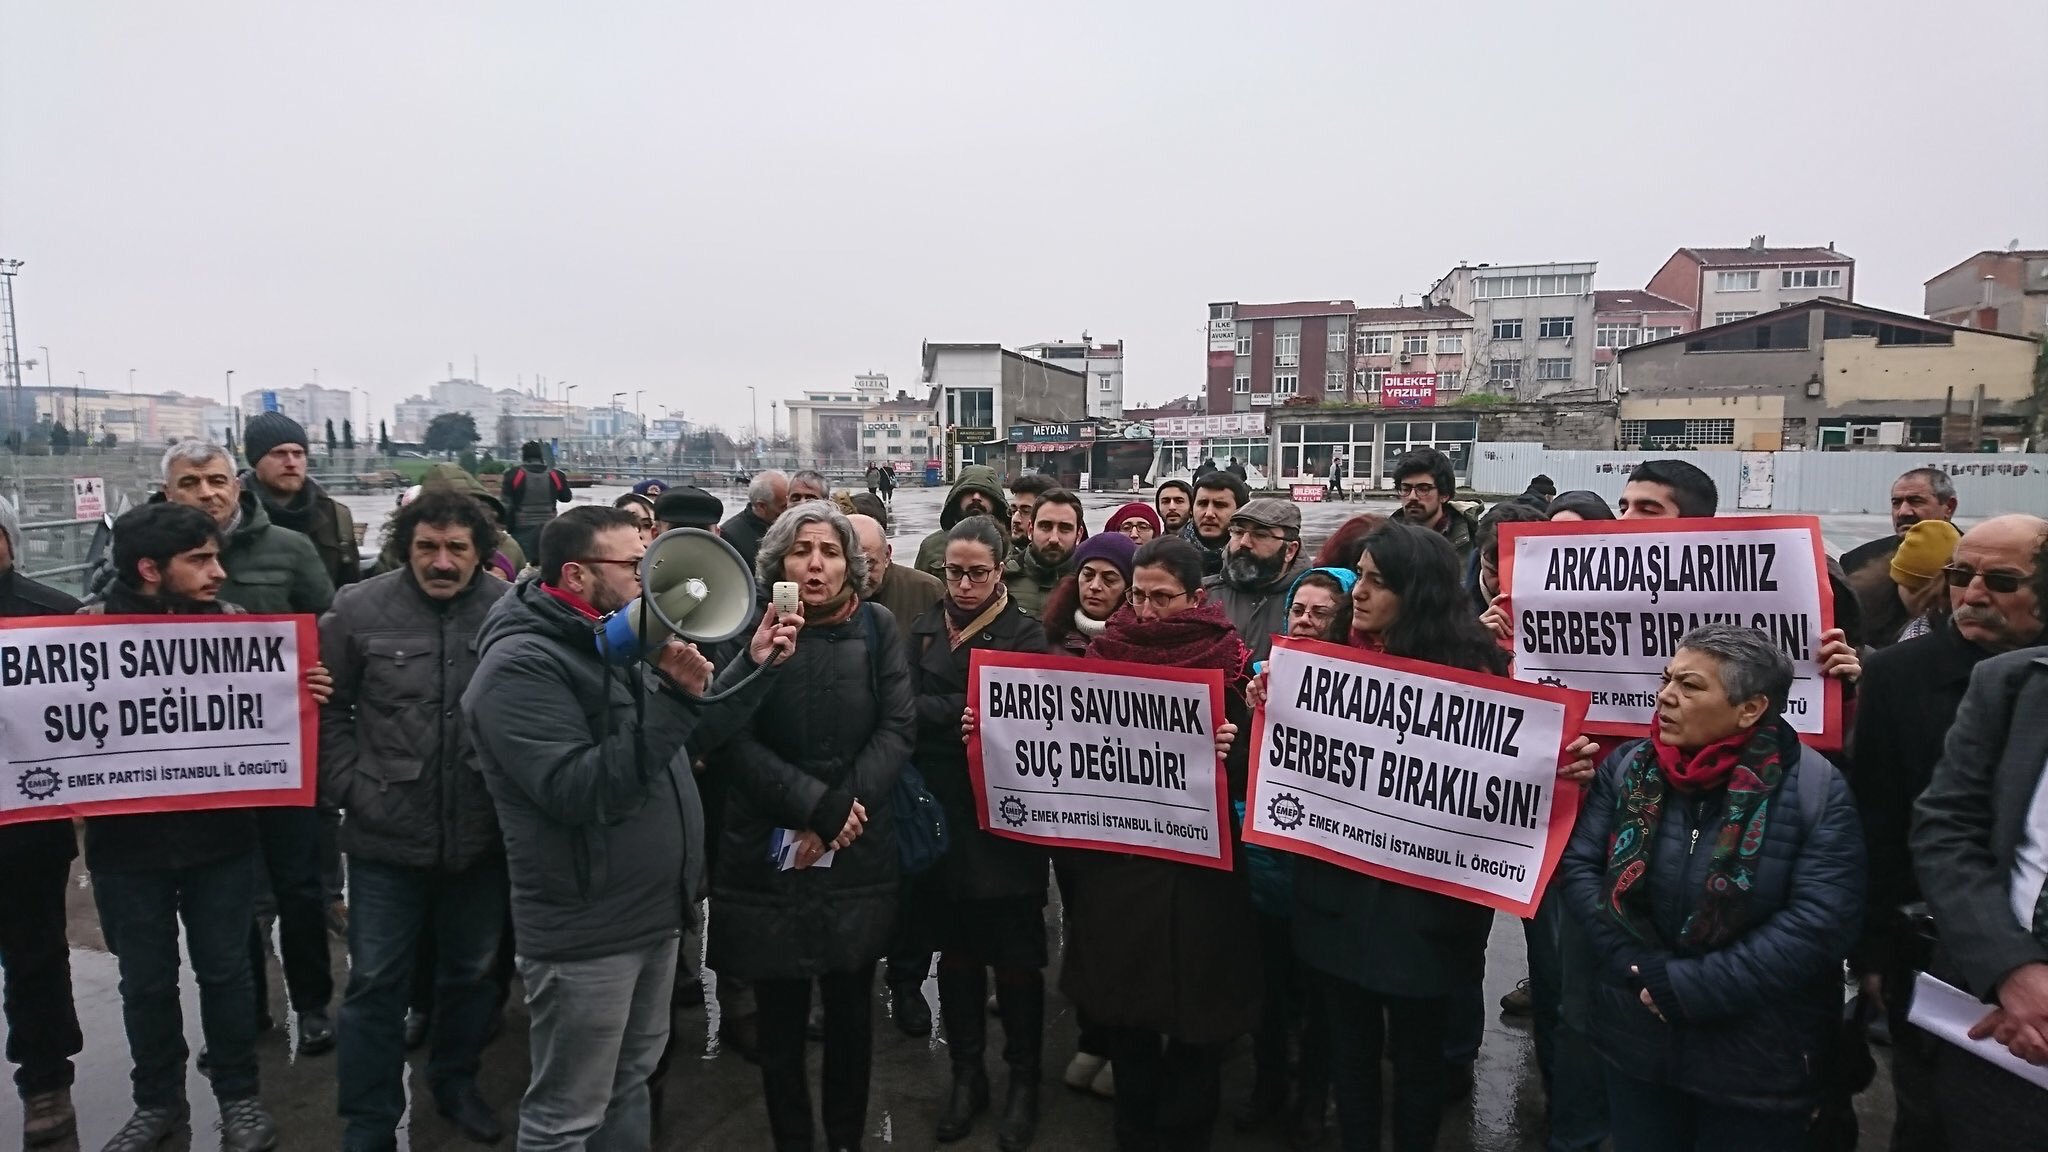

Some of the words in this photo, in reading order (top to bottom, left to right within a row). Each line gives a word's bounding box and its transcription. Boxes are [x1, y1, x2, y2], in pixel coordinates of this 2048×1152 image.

[1385, 376, 1434, 388] DİLEKÇE
[1386, 388, 1431, 397] YAZILIR
[1033, 424, 1069, 436] MEYDAN
[1545, 543, 1777, 604] ARKADAŞLARIMIZ
[1523, 610, 1632, 657] SERBEST
[1, 642, 110, 691] BARIŞI
[120, 636, 286, 678] SAVUNMAK
[44, 701, 109, 749] SUÇ
[119, 685, 264, 736] DEĞİLDİR!
[990, 681, 1064, 730] BARIŞI
[1071, 686, 1204, 735] SAVUNMAK
[1296, 665, 1524, 758] ARKADAŞLARIMIZ
[28, 779, 53, 788] EMEP
[68, 773, 105, 788] EMEK
[109, 769, 157, 784] PARTİSİ
[161, 766, 220, 780] İSTANBUL
[224, 764, 235, 776] İL
[239, 760, 287, 775] ÖRGÜTÜ
[1016, 740, 1063, 787] SUÇ
[1070, 736, 1187, 790] DEĞİLDİR!
[1269, 723, 1375, 792] SERBEST
[1378, 750, 1541, 829] BIRAKILSIN!
[1005, 807, 1022, 815] EMEP
[1032, 810, 1059, 823] EMEK
[1062, 811, 1099, 826] PARTİSİ
[1102, 812, 1151, 832] İSTANBUL
[1154, 818, 1163, 833] İL
[1166, 819, 1208, 841] ÖRGÜTÜ
[1276, 806, 1299, 818] EMEP
[1309, 813, 1339, 835] EMEK
[1343, 824, 1387, 849] PARTİSİ
[1390, 835, 1451, 866] İSTANBUL
[1455, 851, 1467, 868] İL
[1471, 854, 1525, 883] ÖRGÜTÜ
